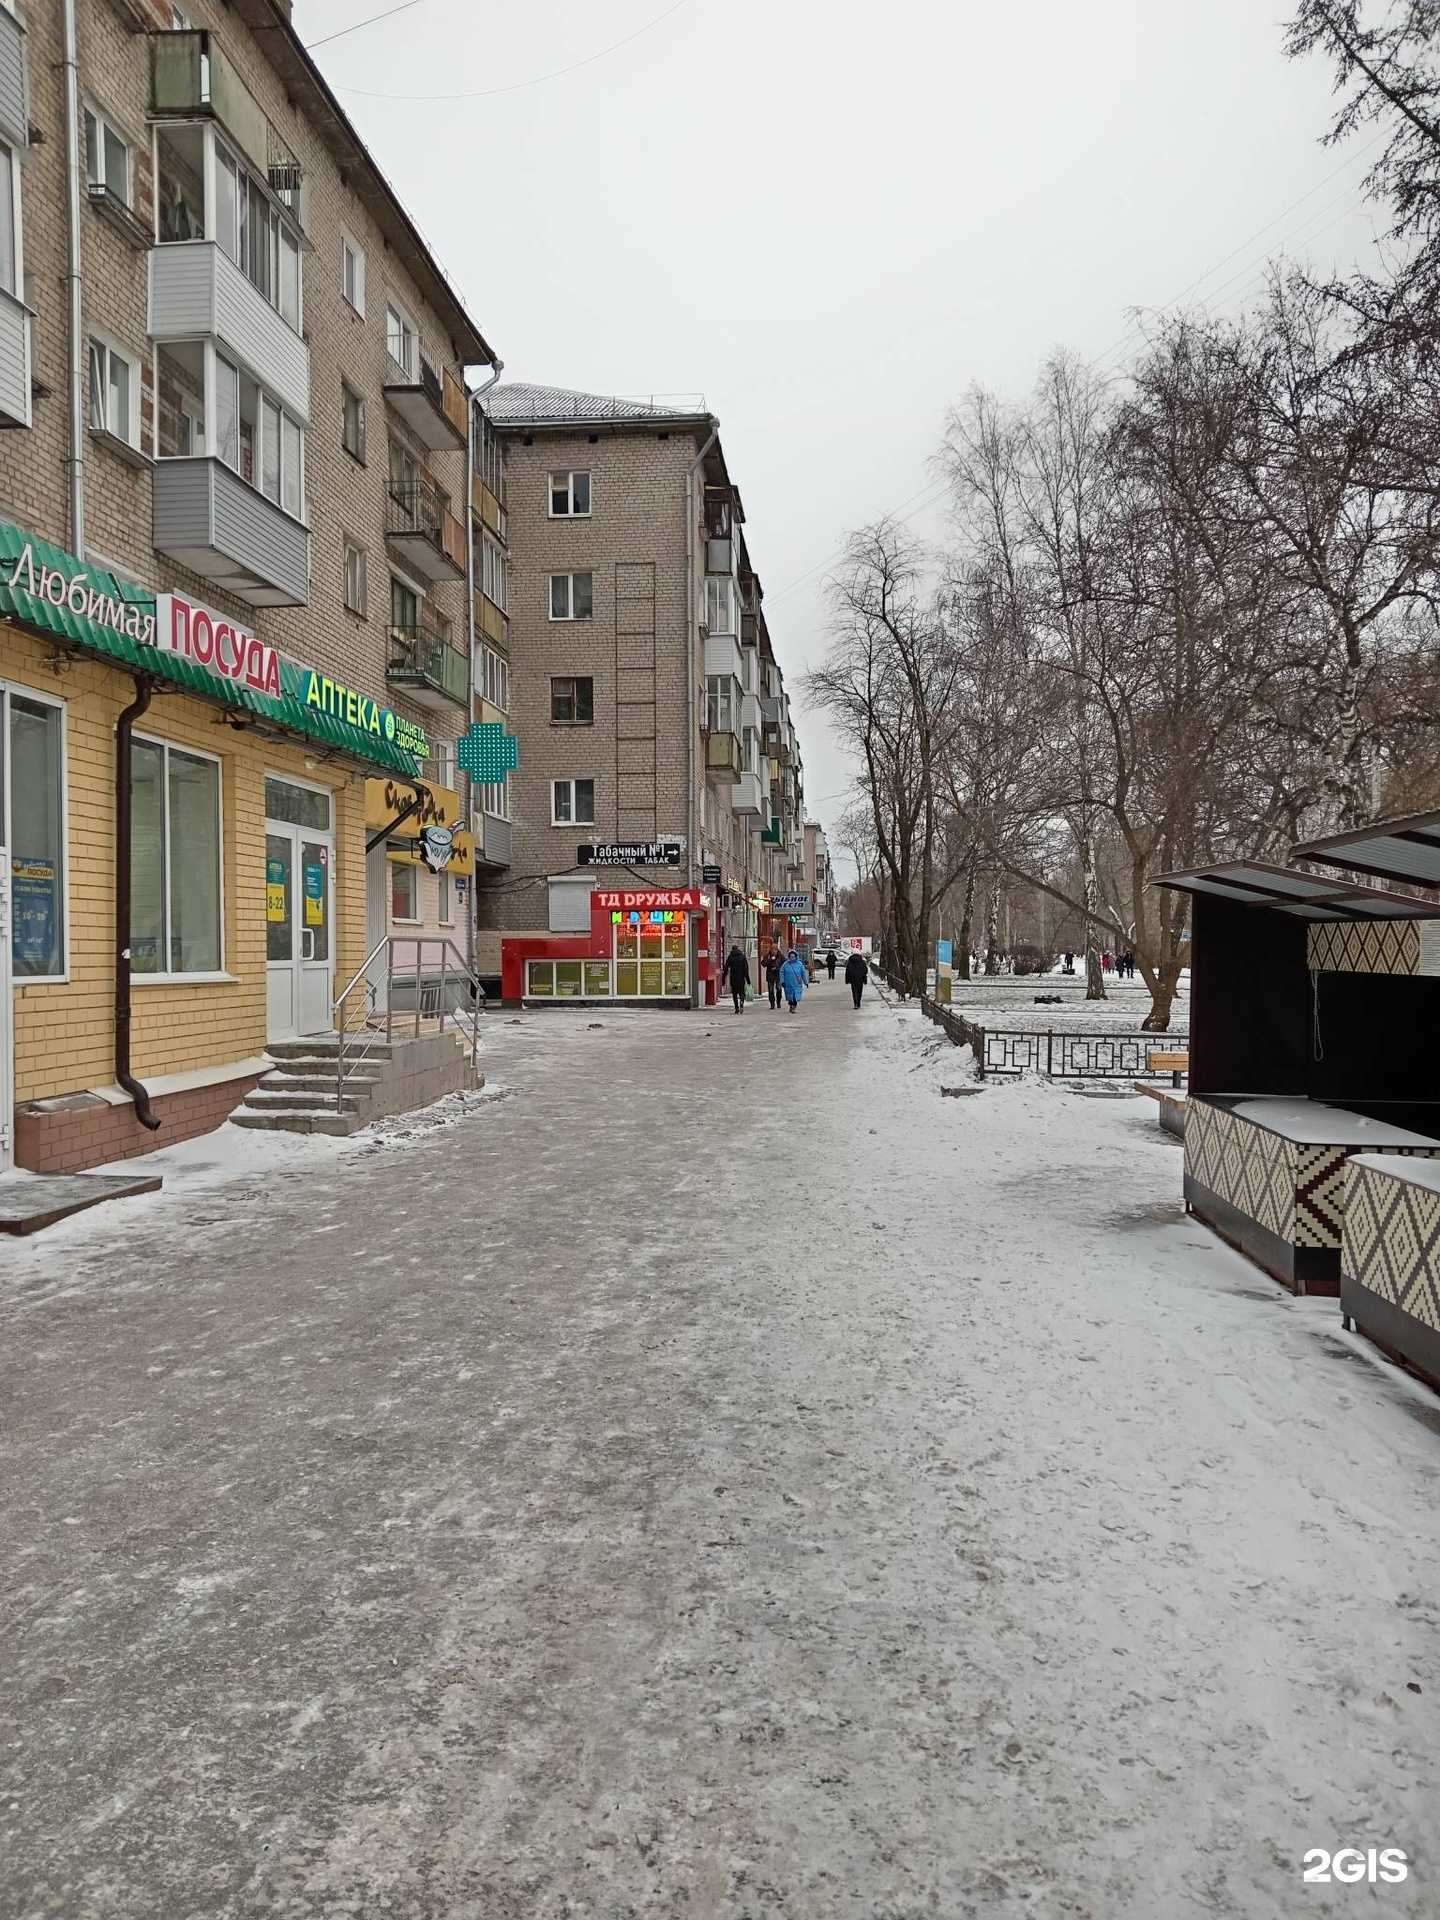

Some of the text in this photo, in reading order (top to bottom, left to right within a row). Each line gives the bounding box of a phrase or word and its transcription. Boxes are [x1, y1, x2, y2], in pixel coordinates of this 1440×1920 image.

[9, 543, 156, 646] Любимая
[171, 592, 281, 700] ПОСУДА
[306, 671, 381, 736] АПТЕКА
[396, 715, 426, 742] ПЛАНЕТА
[588, 857, 670, 865] ЖИДКОСТИ ТАБАК
[592, 844, 665, 857] Табачный №1
[598, 893, 621, 907] ТД
